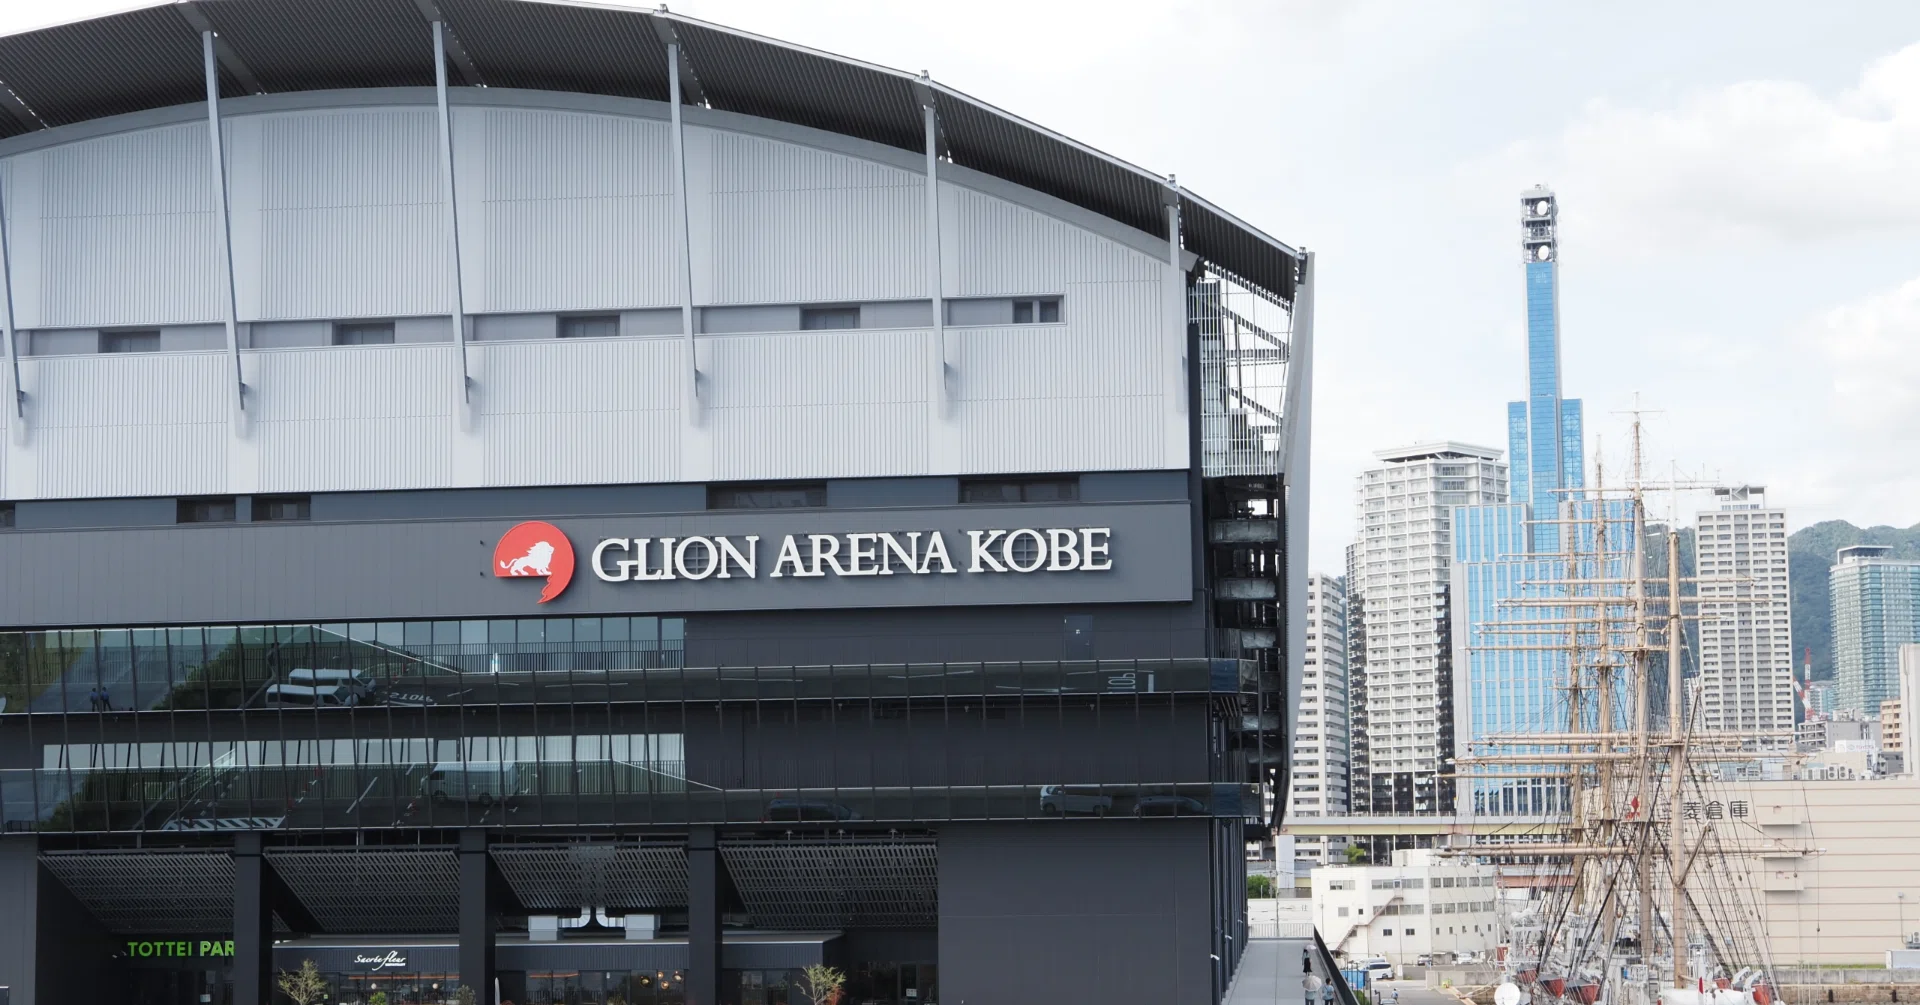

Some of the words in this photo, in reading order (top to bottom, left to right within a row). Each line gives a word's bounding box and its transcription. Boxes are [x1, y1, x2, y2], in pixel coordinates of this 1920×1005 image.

[592, 536, 759, 582] GLION
[770, 531, 957, 577] ARENA
[967, 528, 1112, 573] KOBE
[127, 941, 192, 957] TOTTEI
